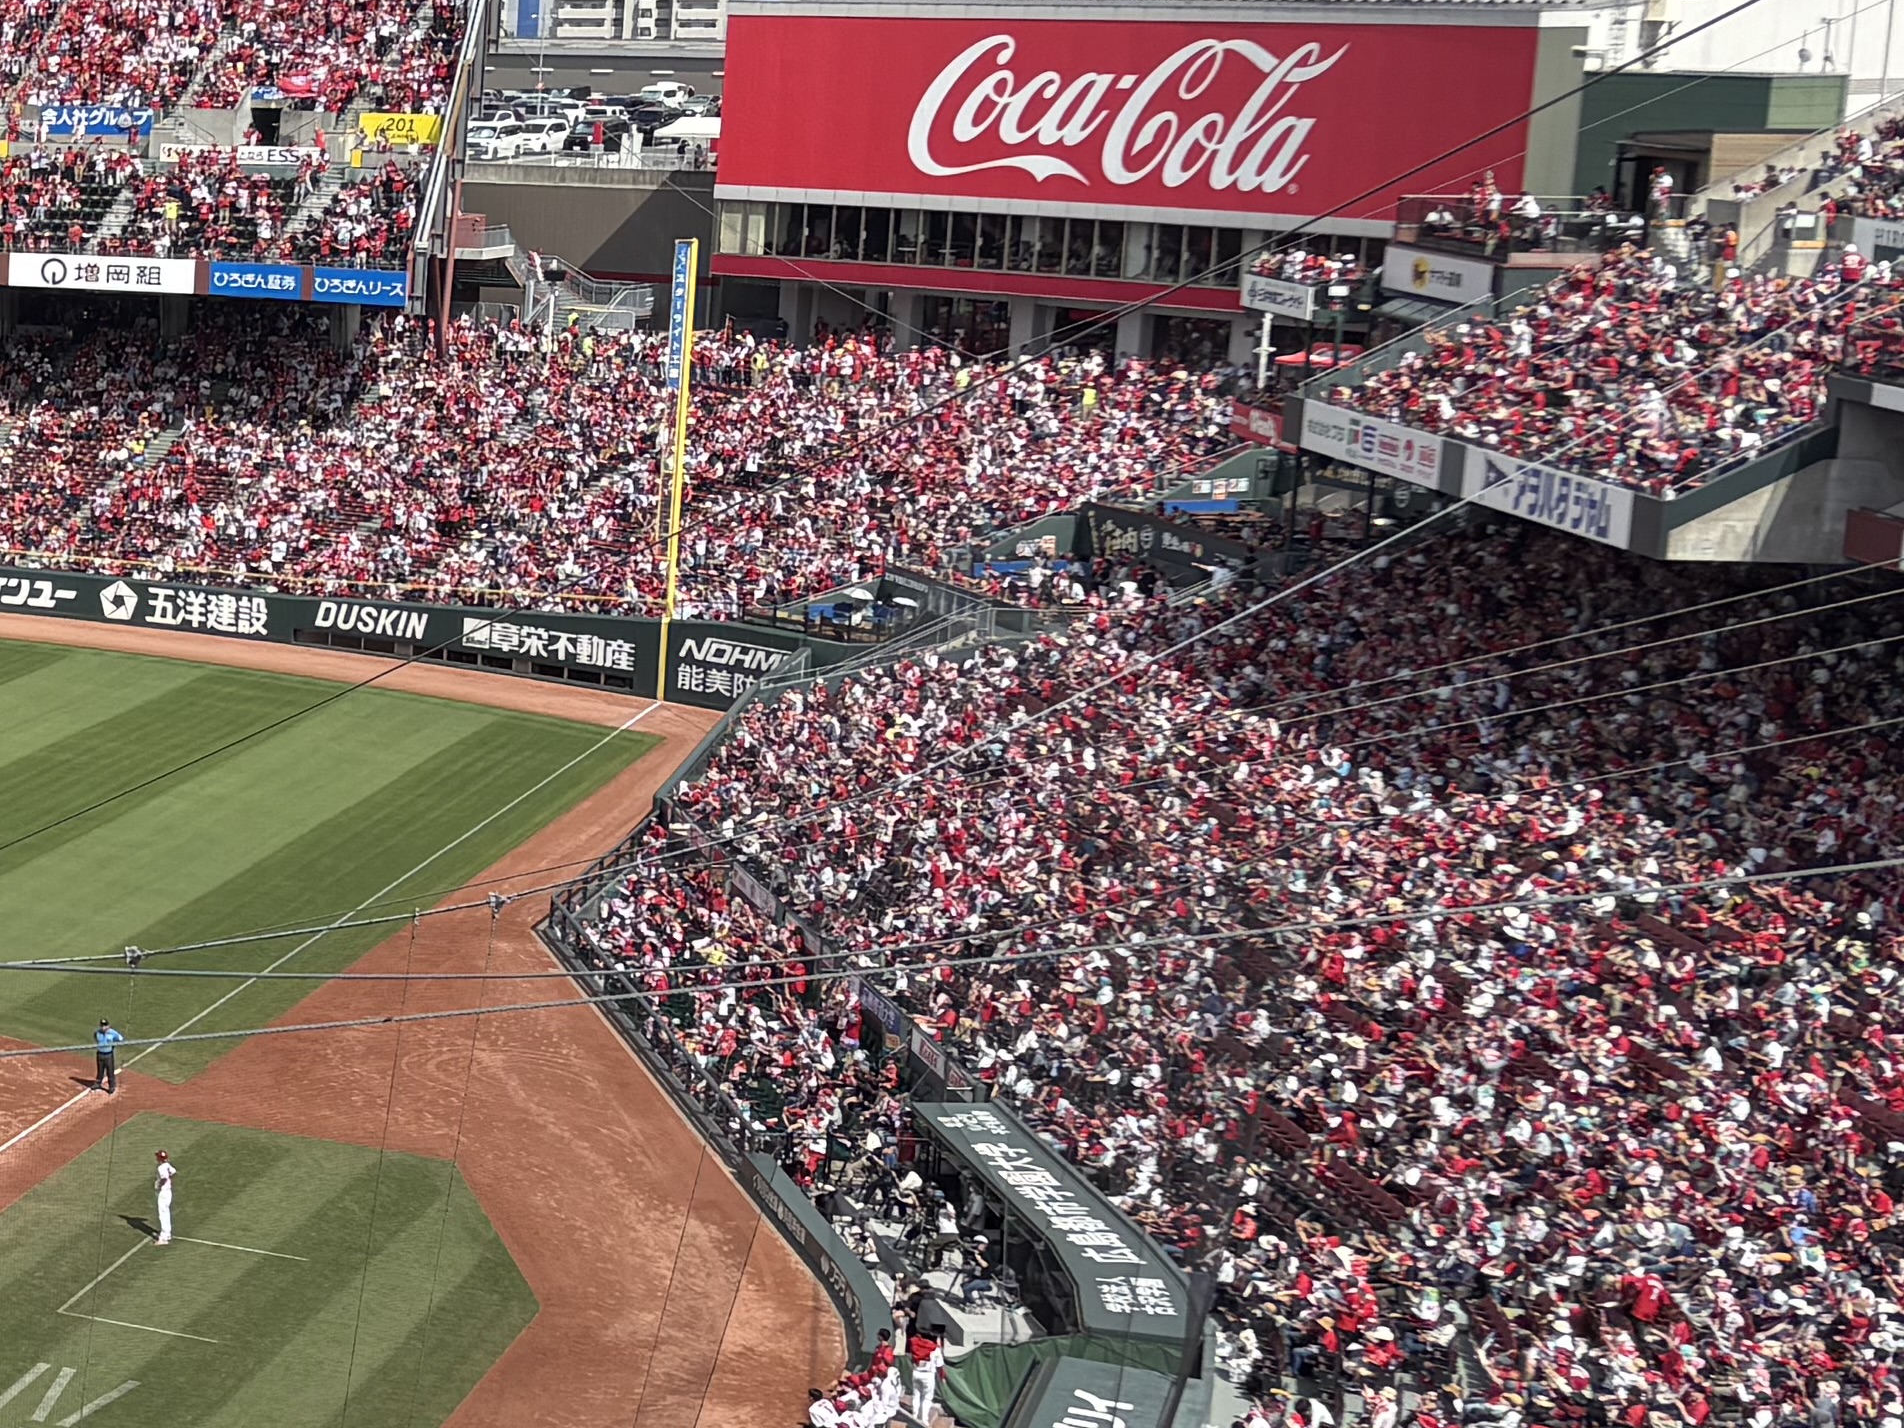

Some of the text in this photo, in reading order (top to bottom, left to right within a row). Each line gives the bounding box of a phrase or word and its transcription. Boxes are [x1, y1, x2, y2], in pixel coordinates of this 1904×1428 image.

[385, 118, 415, 133] 201
[906, 33, 1350, 195] Coca-Cola
[74, 261, 162, 287] 増岡組
[314, 276, 405, 298] ひろぎんリース
[144, 585, 270, 637] 五洋建設
[314, 601, 430, 641] DUSKIN
[488, 622, 636, 672] 章栄不動産
